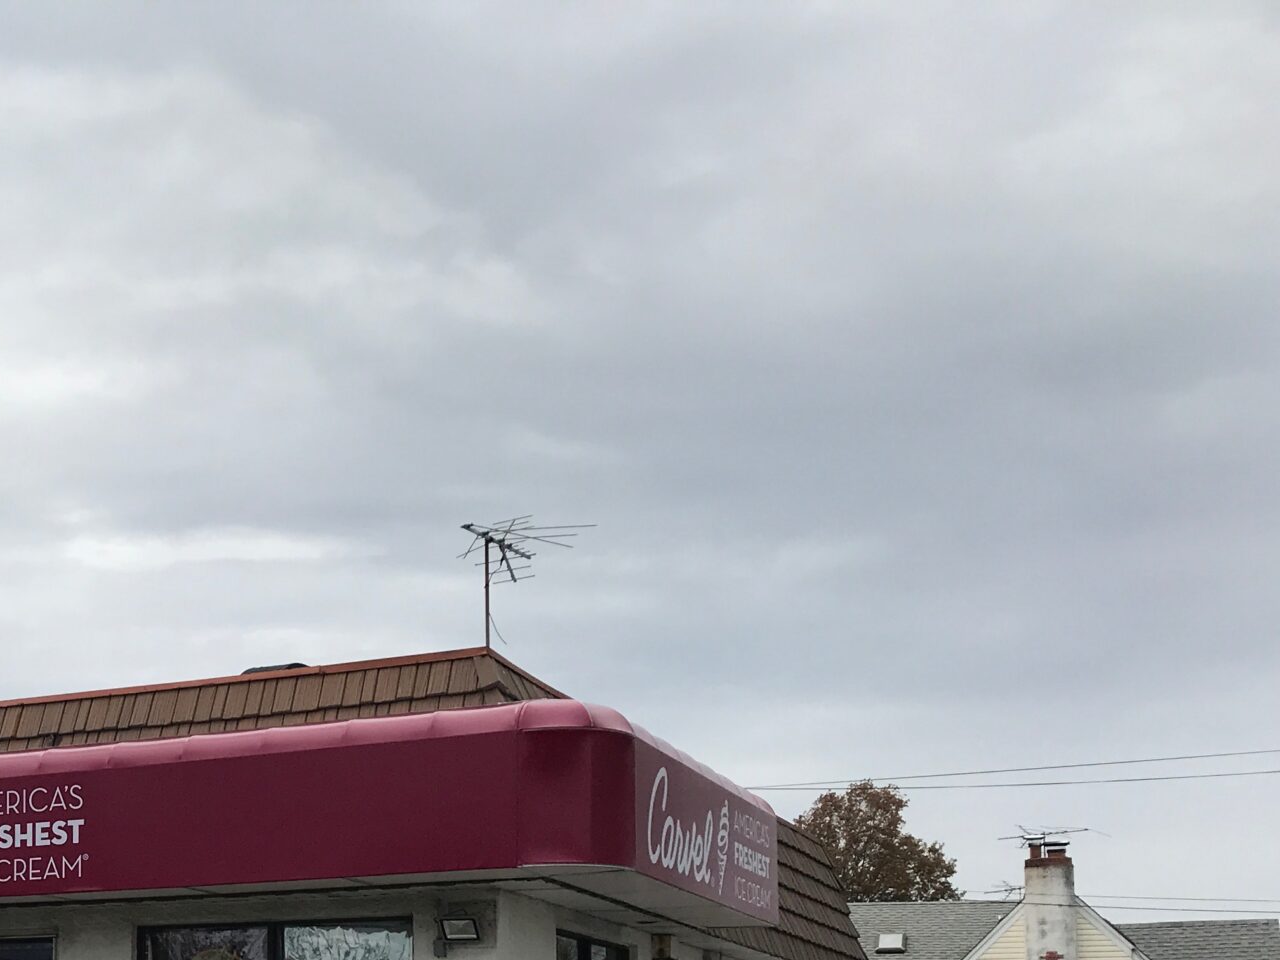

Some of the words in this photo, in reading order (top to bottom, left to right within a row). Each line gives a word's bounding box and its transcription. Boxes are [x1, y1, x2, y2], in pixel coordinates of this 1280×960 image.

[647, 766, 713, 885] Carvel
[734, 841, 771, 880] FRESHEST
[735, 878, 747, 899] ICE
[747, 881, 771, 910] CREAM
